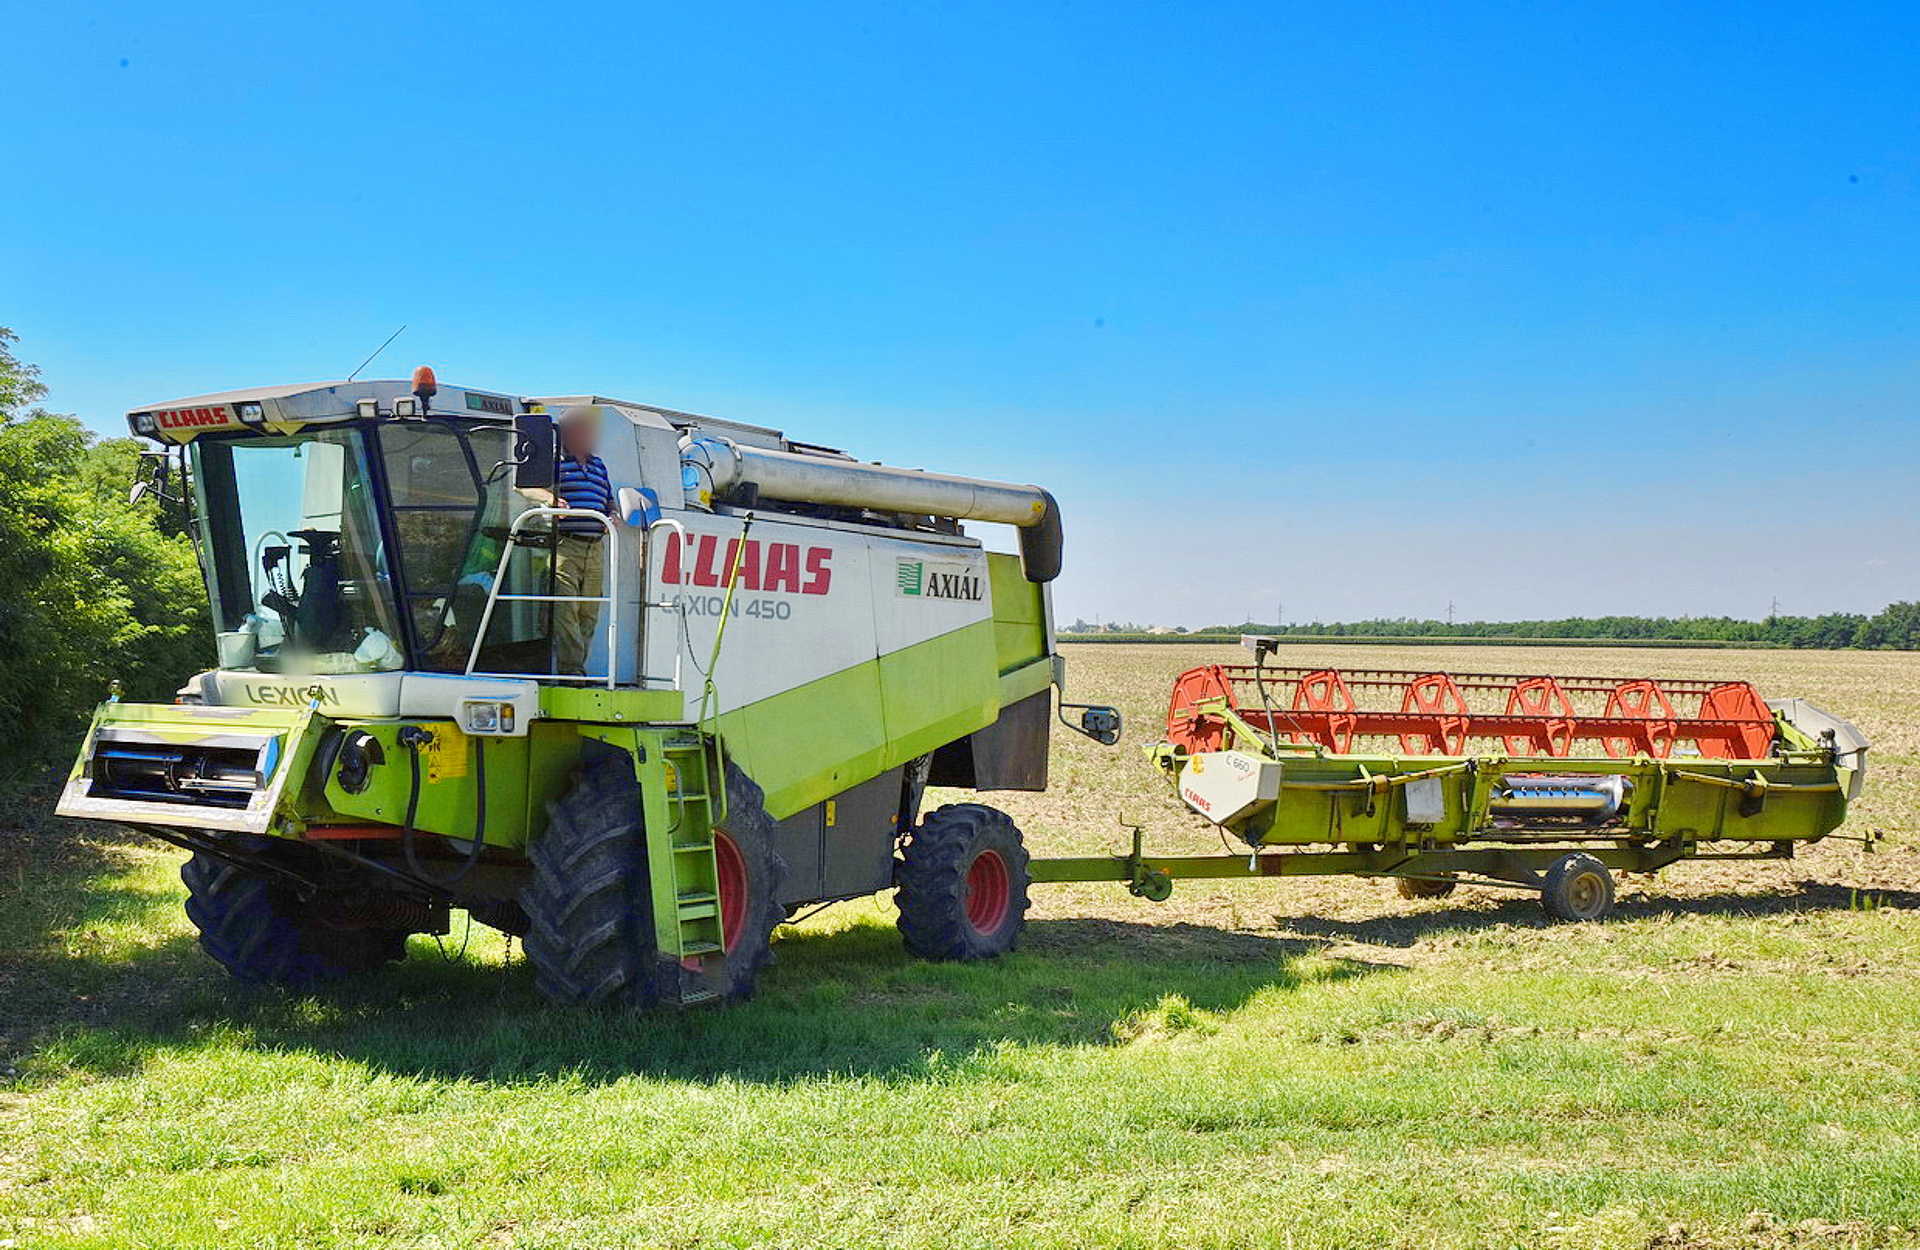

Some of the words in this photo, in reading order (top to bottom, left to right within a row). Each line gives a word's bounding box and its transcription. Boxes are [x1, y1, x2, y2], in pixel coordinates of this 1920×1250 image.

[159, 407, 229, 428] CLAAS
[661, 531, 833, 596] CLAAS
[926, 567, 983, 601] AXIÁL
[745, 599, 791, 620] 450
[1184, 787, 1212, 813] CLAAS
